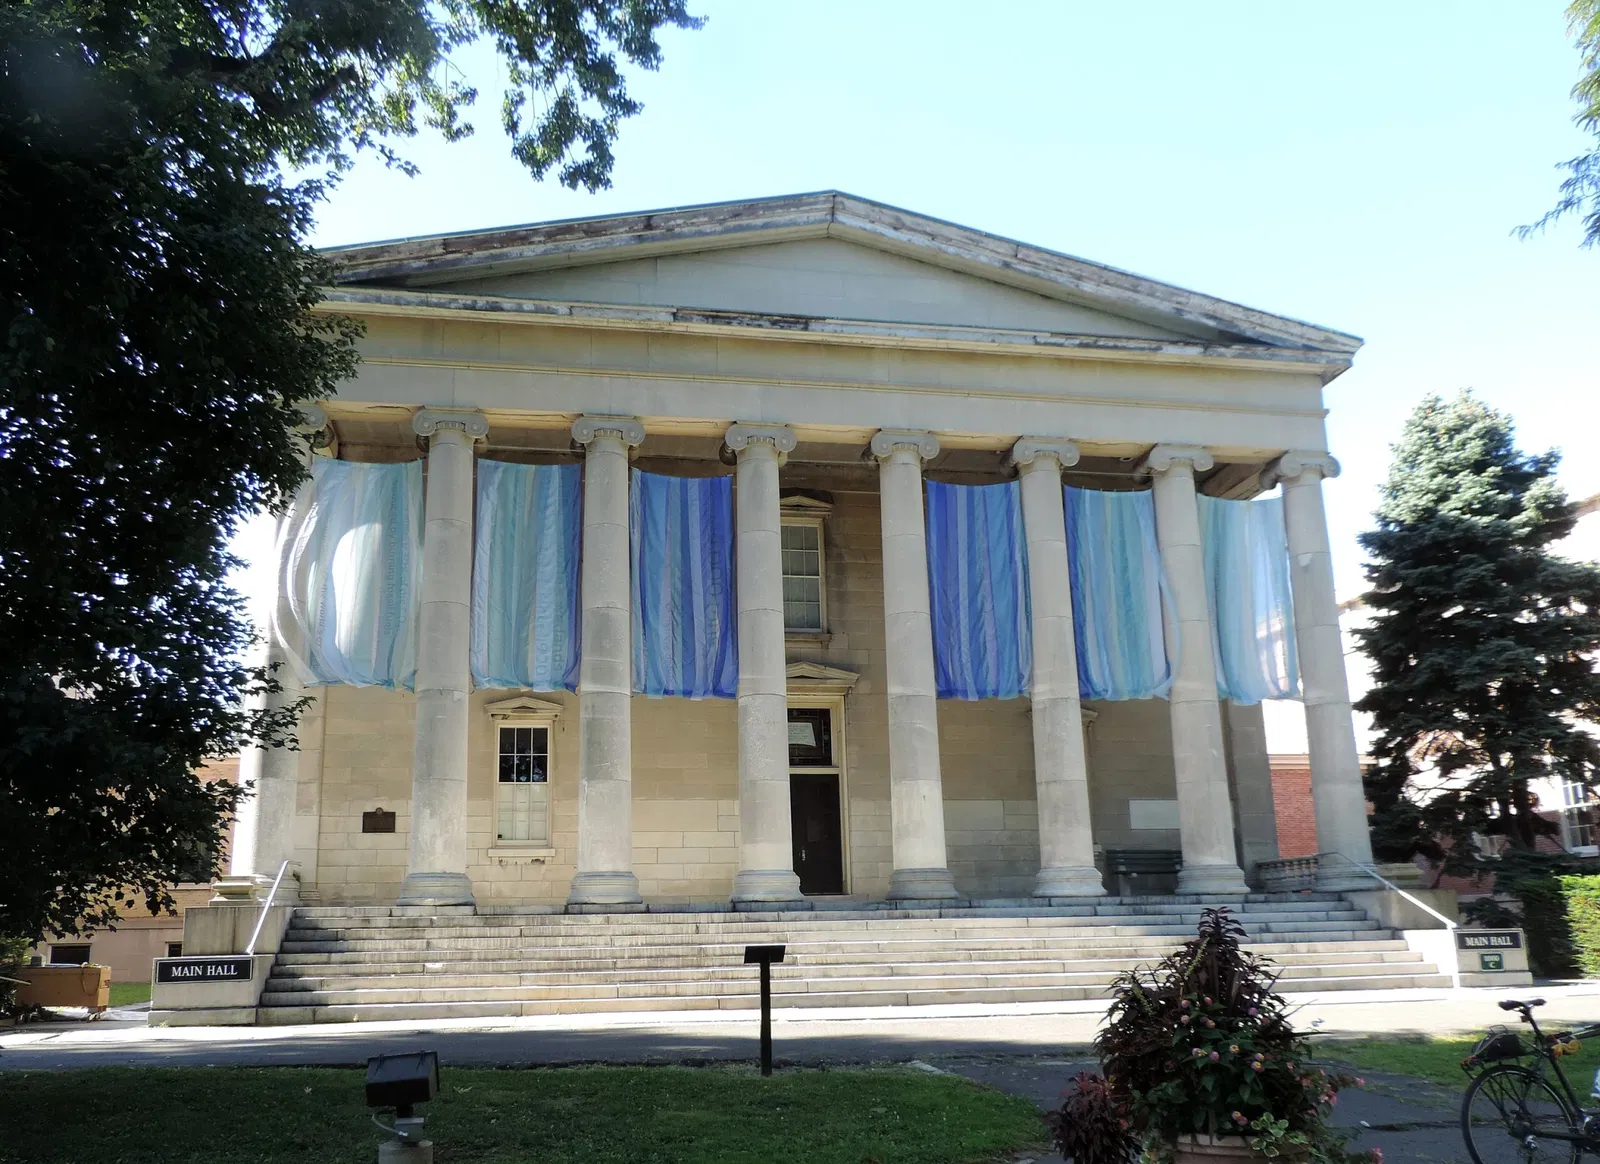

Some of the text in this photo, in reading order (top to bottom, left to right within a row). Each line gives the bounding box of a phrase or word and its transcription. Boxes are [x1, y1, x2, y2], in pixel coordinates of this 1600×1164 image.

[1464, 936, 1514, 947] MAIN HALL
[171, 964, 238, 977] MAIN HALL
